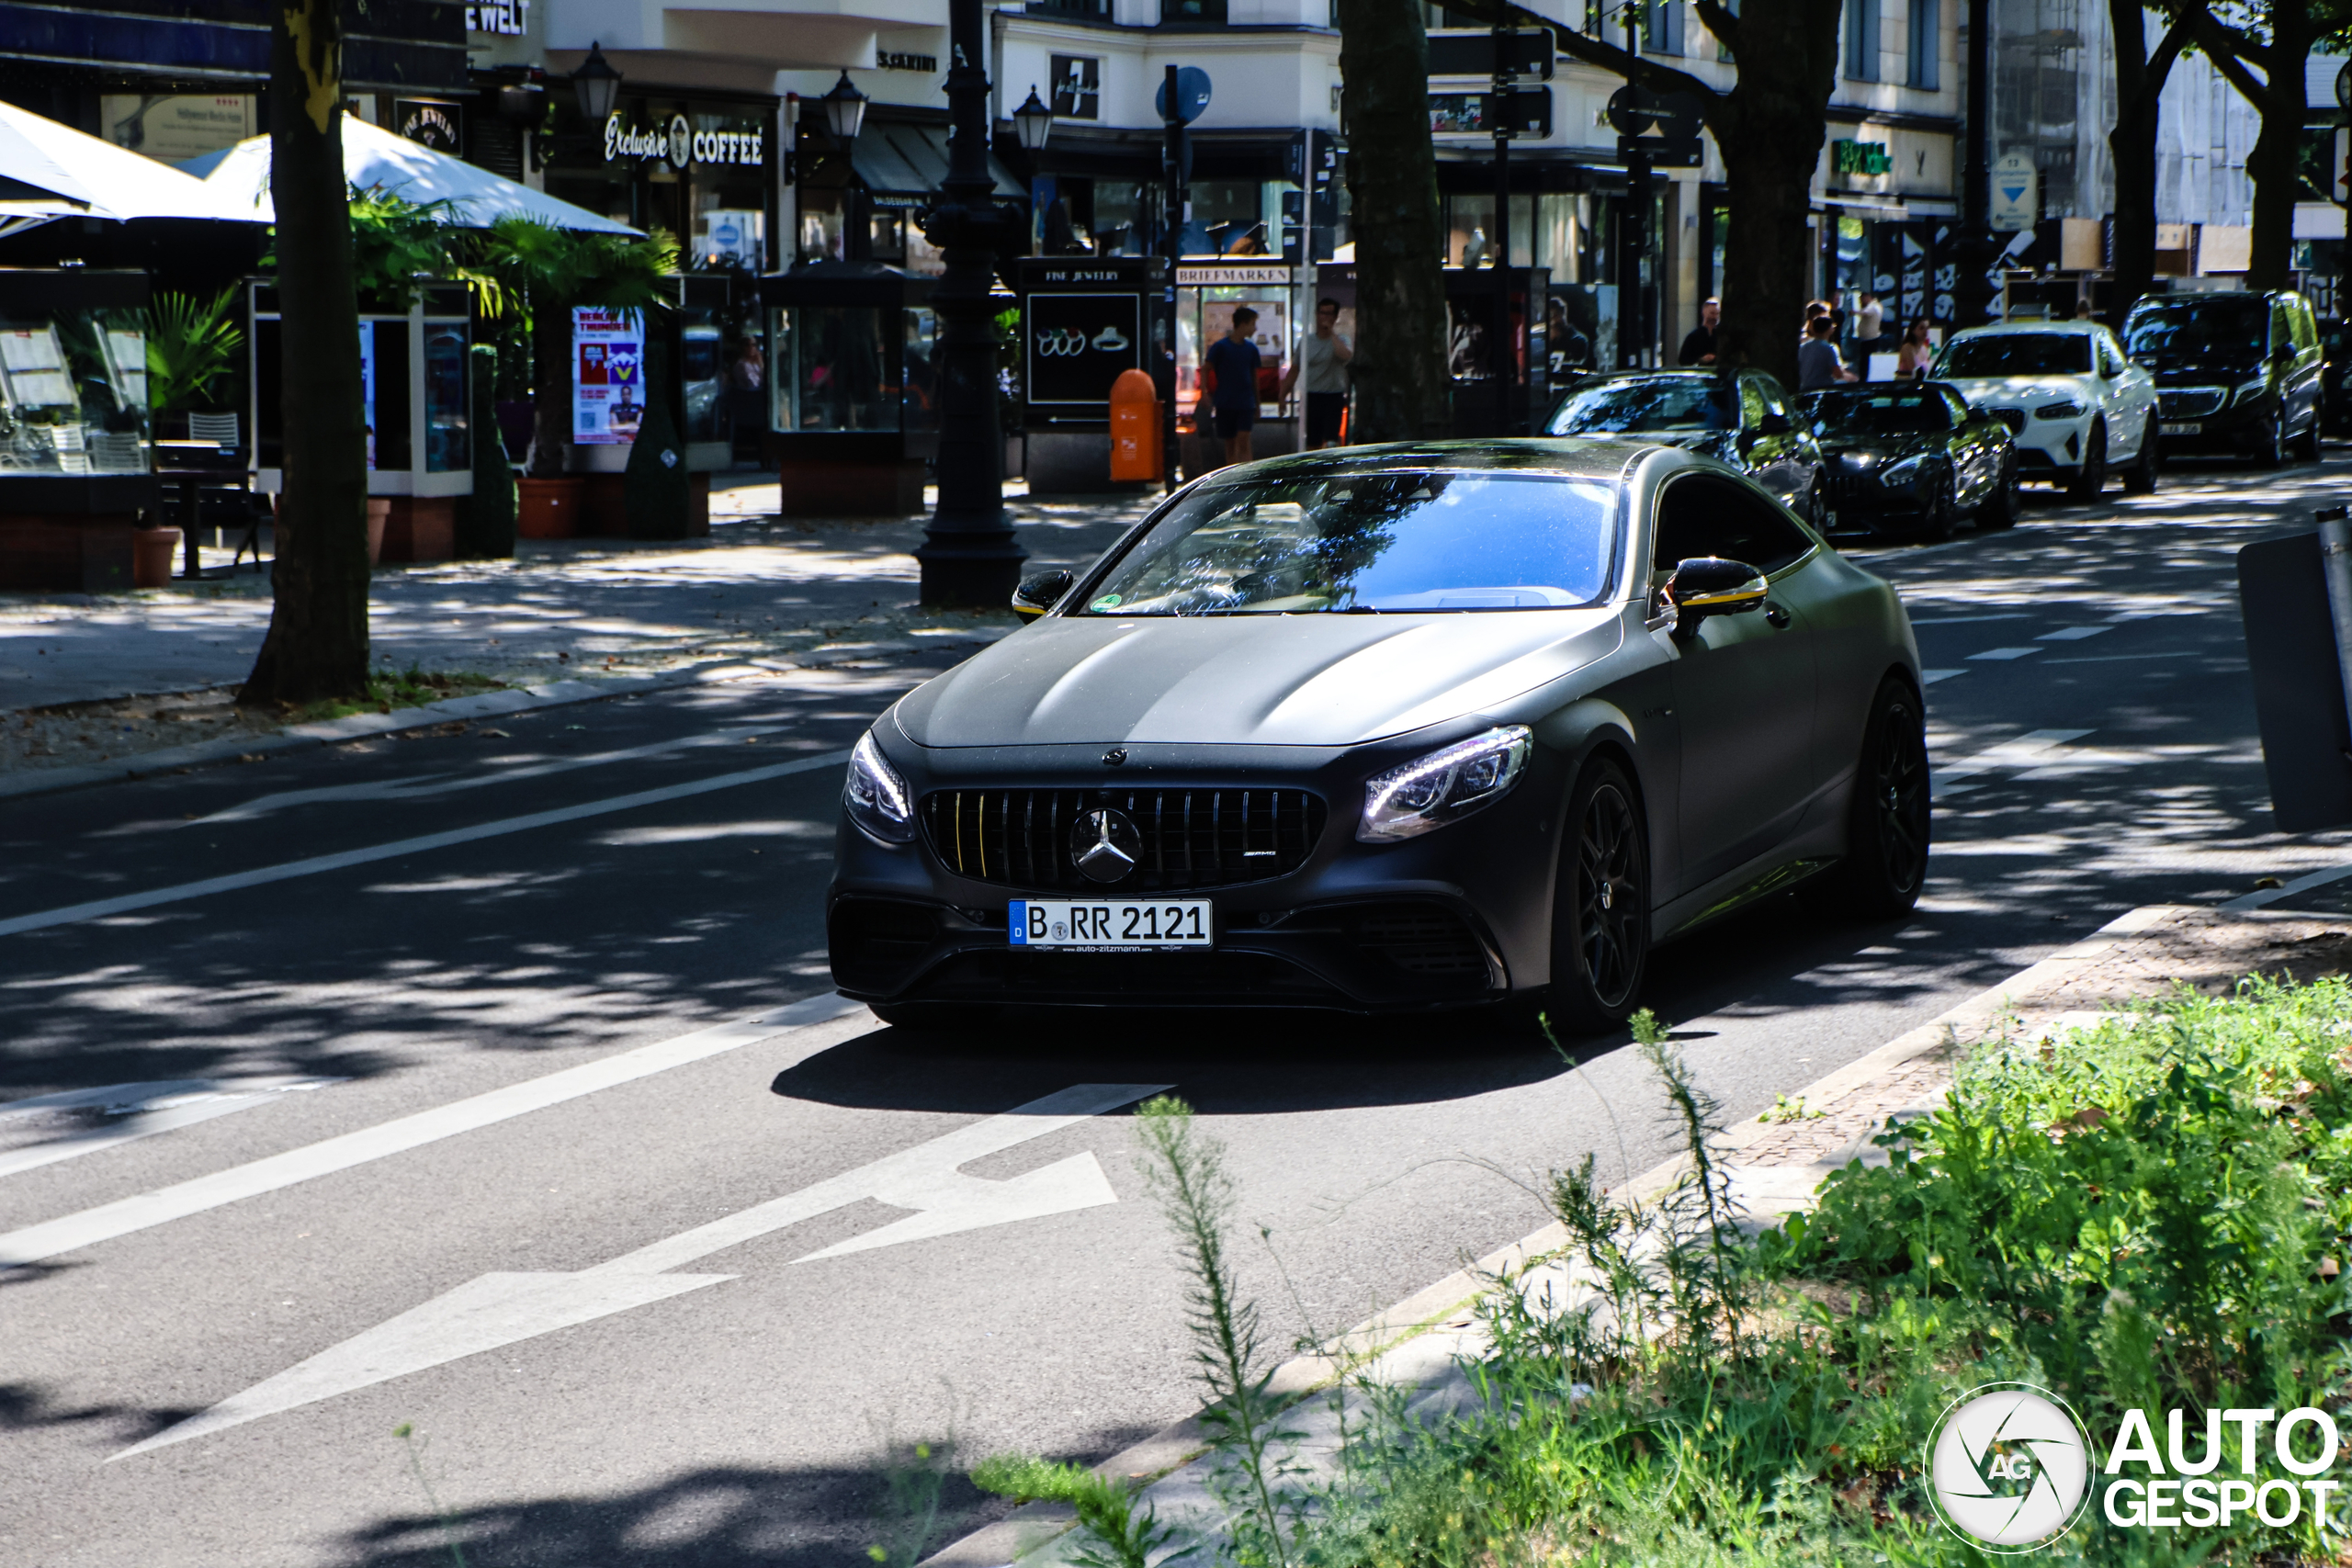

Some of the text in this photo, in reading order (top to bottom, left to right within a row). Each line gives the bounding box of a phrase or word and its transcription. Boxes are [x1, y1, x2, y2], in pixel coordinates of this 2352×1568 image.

[480, 0, 530, 35] WELT
[605, 113, 763, 165] Exclusive COFFEE
[1046, 272, 1119, 283] FINE JEWELRY
[1179, 269, 1288, 282] BRIEFMARKEN
[1028, 907, 1205, 940] B RR 2121
[1014, 928, 1023, 938] D
[1062, 945, 1153, 953] www.auto-zitzmann.com
